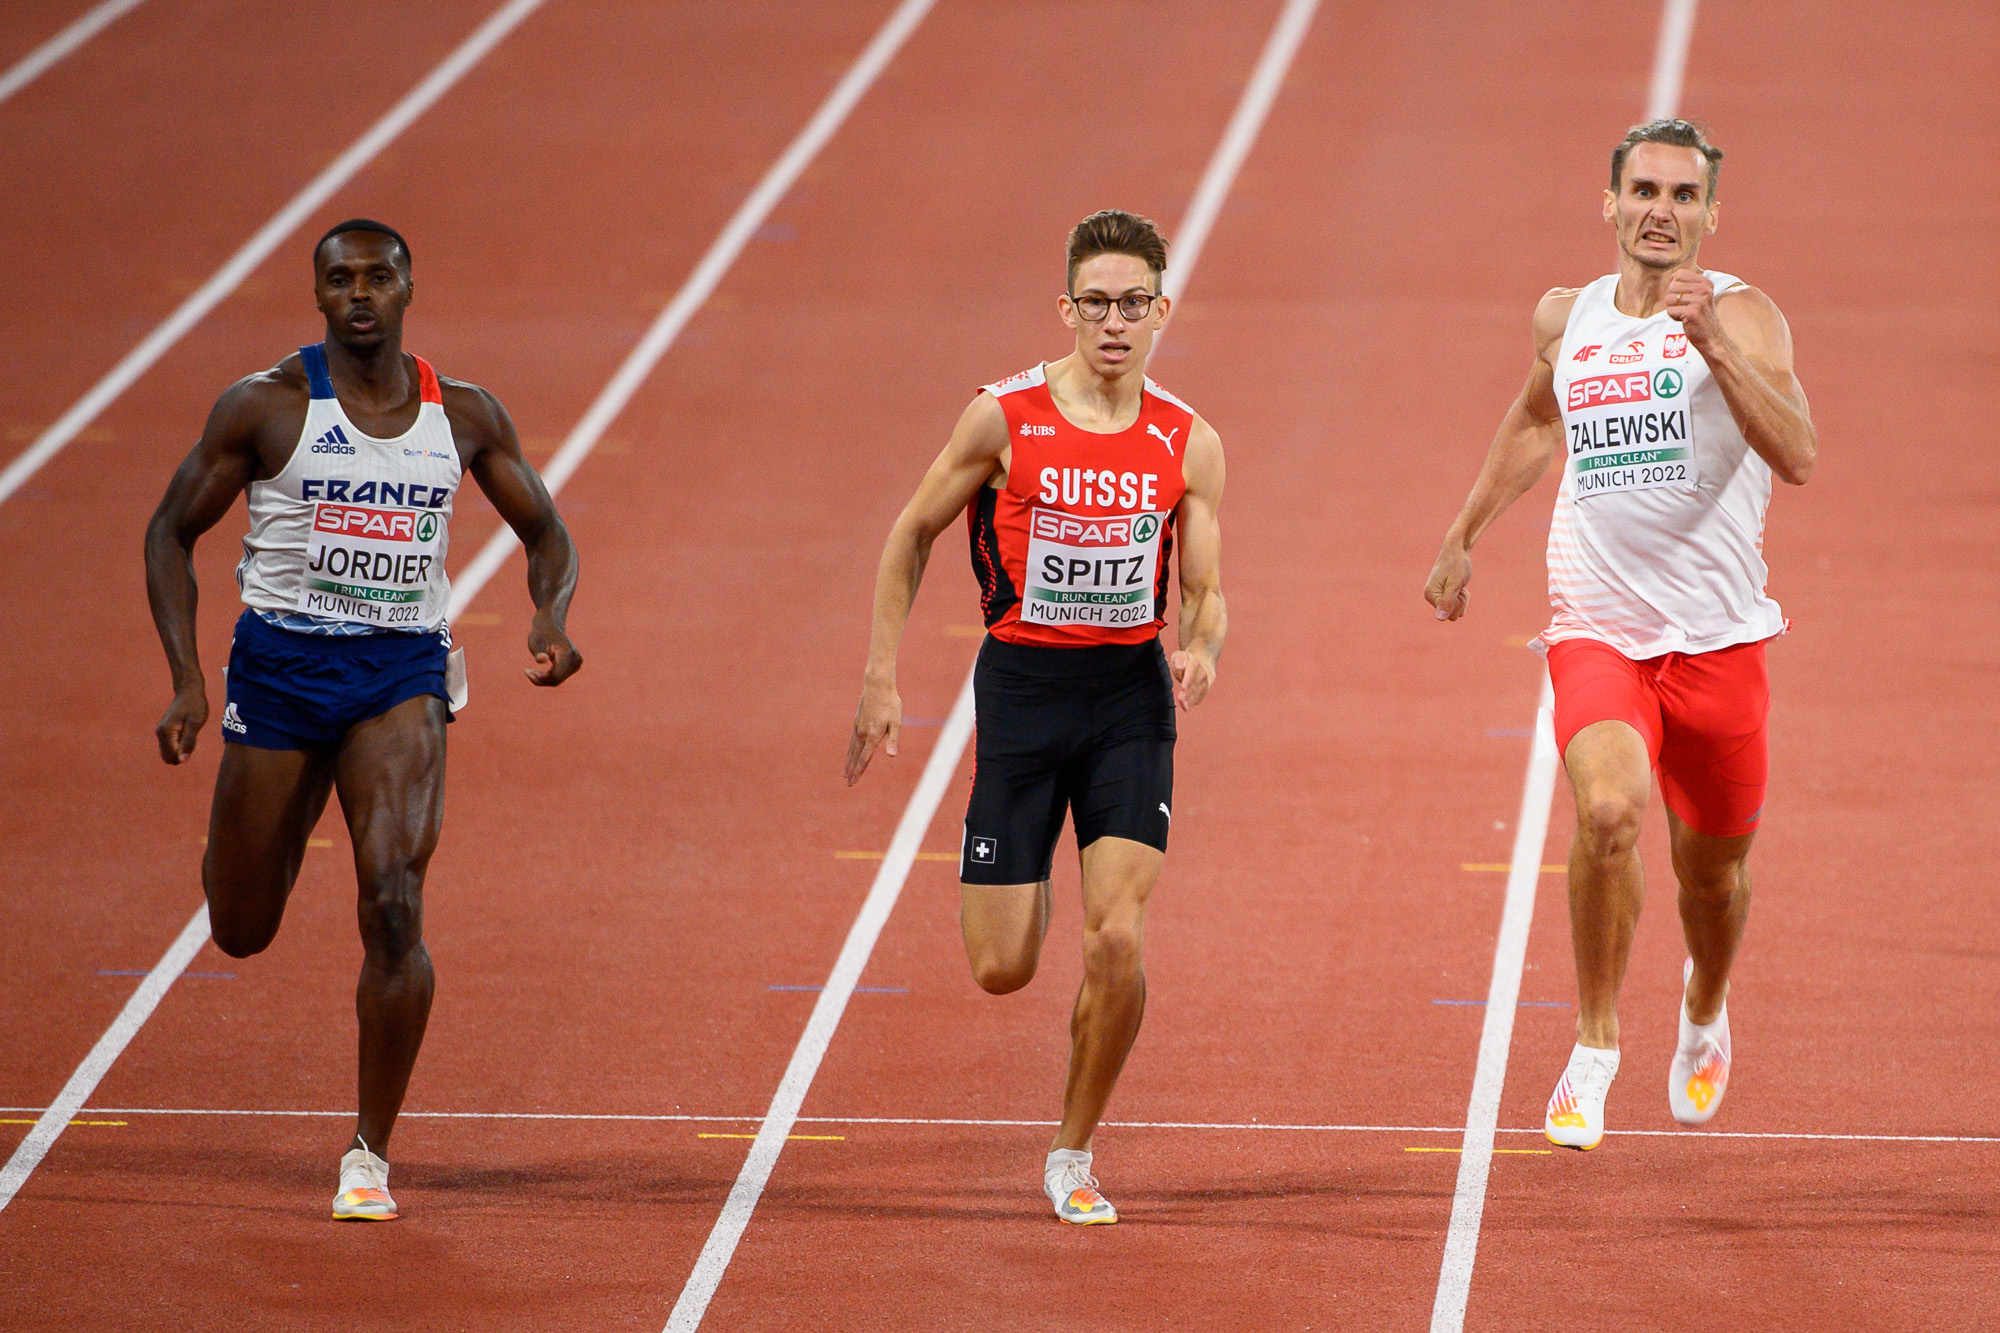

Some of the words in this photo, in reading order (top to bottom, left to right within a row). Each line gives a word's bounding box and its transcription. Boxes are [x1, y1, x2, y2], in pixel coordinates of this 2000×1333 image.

[1572, 345, 1603, 362] 4F
[1611, 355, 1643, 364] ORLEN
[1569, 375, 1649, 407] SPAR
[1032, 425, 1056, 437] UBS
[1571, 410, 1686, 455] ZALEWSKI
[311, 443, 356, 455] adidas
[1594, 455, 1618, 467] RUN
[1577, 469, 1635, 493] MUNICH
[1641, 464, 1686, 484] 2022
[302, 479, 450, 508] FRANCE
[317, 508, 413, 538] SPAR
[1036, 515, 1129, 544] SPAR
[308, 545, 432, 584] JORDIER
[1041, 554, 1145, 587] SPITZ
[340, 585, 367, 598] RUN
[1061, 592, 1087, 603] RUN
[307, 593, 382, 621] MUNICH
[387, 605, 419, 622] 2022
[1030, 602, 1103, 622] MUNICH
[1109, 604, 1147, 623] 2022
